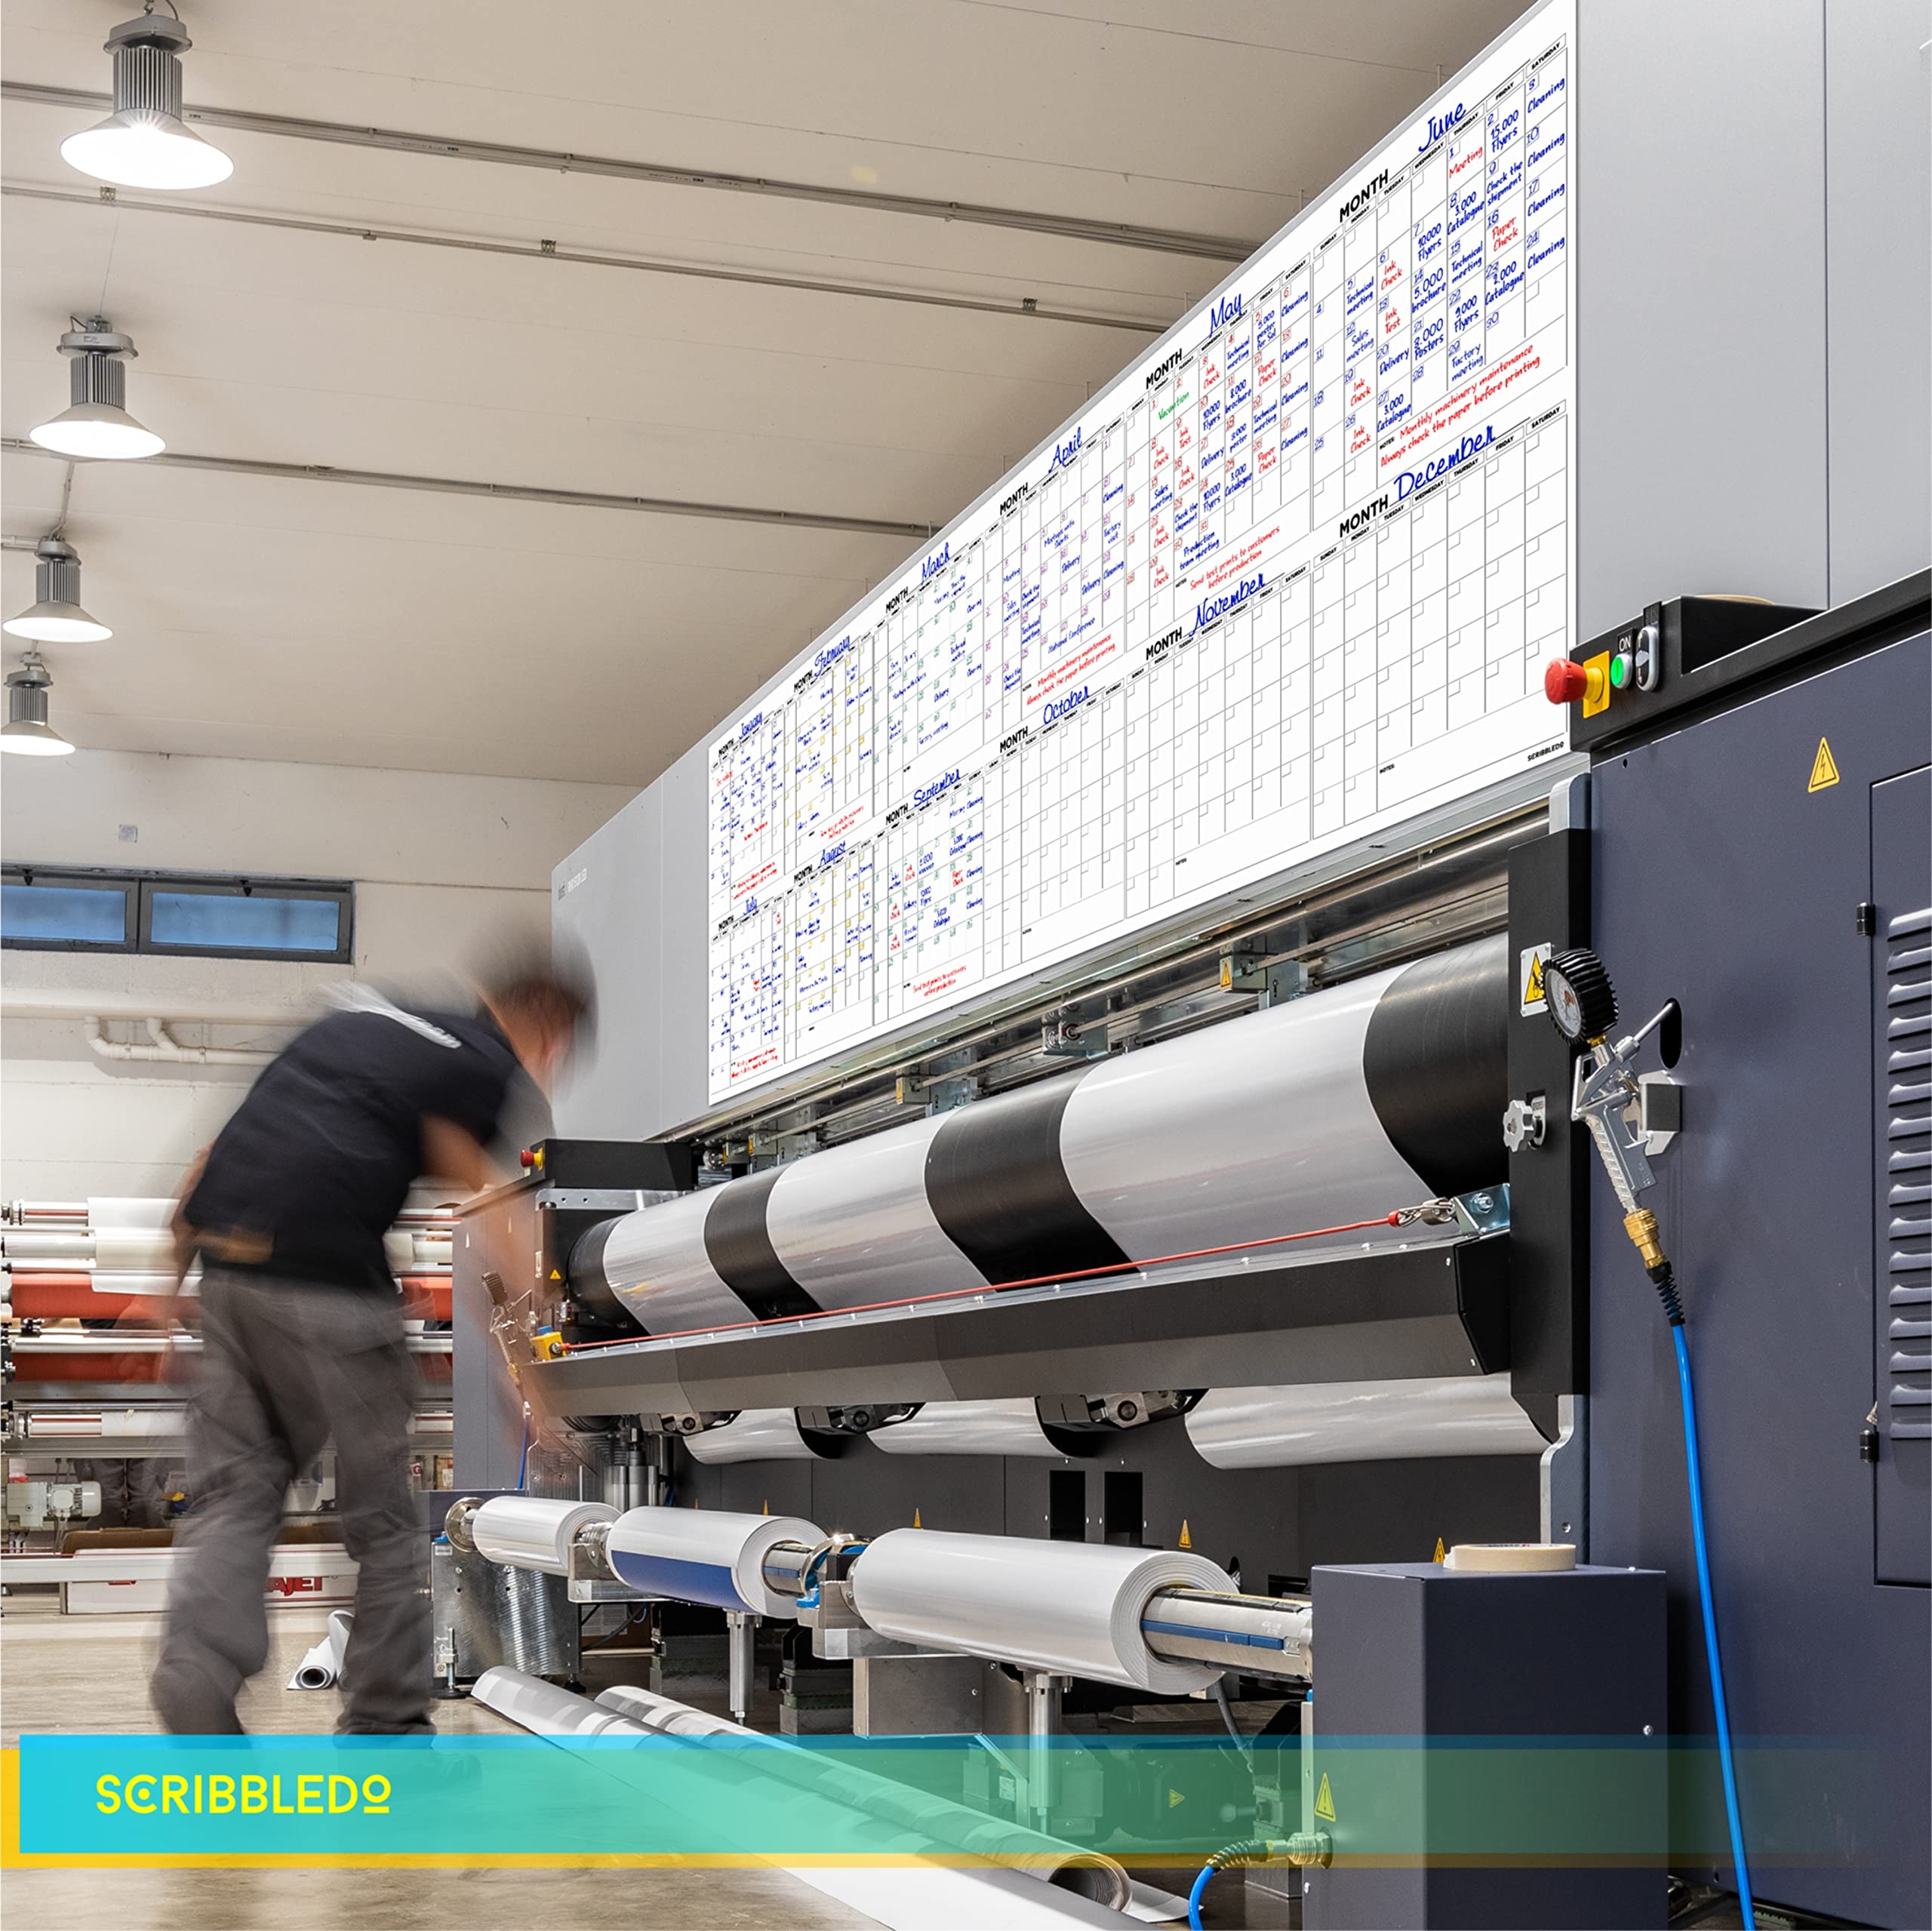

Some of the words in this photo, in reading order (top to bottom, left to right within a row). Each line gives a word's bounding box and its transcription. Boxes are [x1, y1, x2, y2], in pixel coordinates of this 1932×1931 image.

[1531, 42, 1560, 69] SATURDAY
[1527, 78, 1564, 113] Cleaning
[1418, 103, 1466, 152] June
[1487, 113, 1494, 126] 2
[1491, 127, 1518, 152] Flyers
[1527, 126, 1539, 145] 10
[1449, 146, 1482, 178] Meeting
[1527, 133, 1564, 168] Cleaning
[1487, 172, 1507, 194] Check
[1509, 161, 1523, 175] the
[1487, 173, 1521, 206] shipment
[1528, 178, 1539, 197] 17
[1340, 168, 1388, 223] MONTH
[1450, 192, 1457, 209] 8
[1527, 183, 1564, 217] Cleaning
[1447, 201, 1484, 235] Catalogue
[1487, 210, 1499, 229] 16
[1492, 217, 1516, 239] Paper
[1418, 238, 1441, 261] Flyers
[1493, 227, 1518, 252] Check
[1527, 232, 1538, 249] 24
[1527, 237, 1564, 269] Cleaning
[1380, 252, 1386, 263] 6
[1384, 260, 1396, 275] Ink
[1451, 241, 1482, 272] Technical
[1381, 268, 1402, 291] Check
[1414, 267, 1443, 300] 5.000
[1452, 257, 1482, 284] meeting
[1346, 276, 1374, 305] Technical
[1412, 282, 1446, 313] brochure
[1485, 272, 1524, 306] Catalogue
[1209, 293, 1241, 338] May
[1281, 291, 1309, 317] Cleaning
[1386, 307, 1397, 321] Ink
[1385, 317, 1401, 334] Test
[1414, 318, 1443, 349] 3.000
[1454, 310, 1478, 333] Flyers
[1486, 312, 1499, 328] 30
[1281, 338, 1309, 363] Cleaning
[1352, 329, 1369, 347] Sales
[1415, 334, 1444, 361] Posters
[1146, 348, 1183, 390] MONTH
[1380, 348, 1409, 375] Delivery
[1451, 355, 1484, 382] meeting
[1452, 343, 1481, 368] Factory
[1281, 382, 1309, 406] Cleaning
[1350, 386, 1371, 407] Check
[1354, 378, 1365, 392] Ink
[1378, 391, 1388, 405] 27
[1400, 412, 1432, 439] Monthly
[1435, 383, 1477, 416] machinery
[1479, 345, 1533, 386] maintenance
[1377, 404, 1411, 432] Catalogue
[1381, 446, 1406, 467] Always
[1408, 429, 1429, 450] check
[1432, 418, 1446, 432] the
[1448, 402, 1472, 426] paper
[1475, 381, 1503, 405] before
[1505, 356, 1540, 388] printing
[1531, 407, 1560, 429] SATURDAY
[1350, 433, 1371, 454] Check
[1354, 426, 1365, 439] Ink
[1496, 435, 1514, 450] FRIDAY
[1048, 426, 1082, 473] April
[1393, 425, 1496, 502] December
[1454, 458, 1478, 477] THURSDAY
[1000, 482, 1028, 515] MONTH
[1414, 480, 1444, 502] WEDNESDAY
[1340, 494, 1389, 538] MONTH
[1384, 504, 1404, 521] TUESDAY
[921, 542, 949, 586] March
[1240, 549, 1246, 557] to
[886, 586, 908, 613] MONTH
[1189, 573, 1266, 638] November
[1146, 626, 1183, 660] MONTH
[1619, 635, 1631, 651] ON
[1043, 686, 1089, 724] October
[1000, 726, 1028, 753] MONTH
[1527, 741, 1564, 762] SCRIBBLEDO
[913, 769, 960, 807] September
[886, 803, 908, 826] MONTH
[817, 841, 845, 869] August
